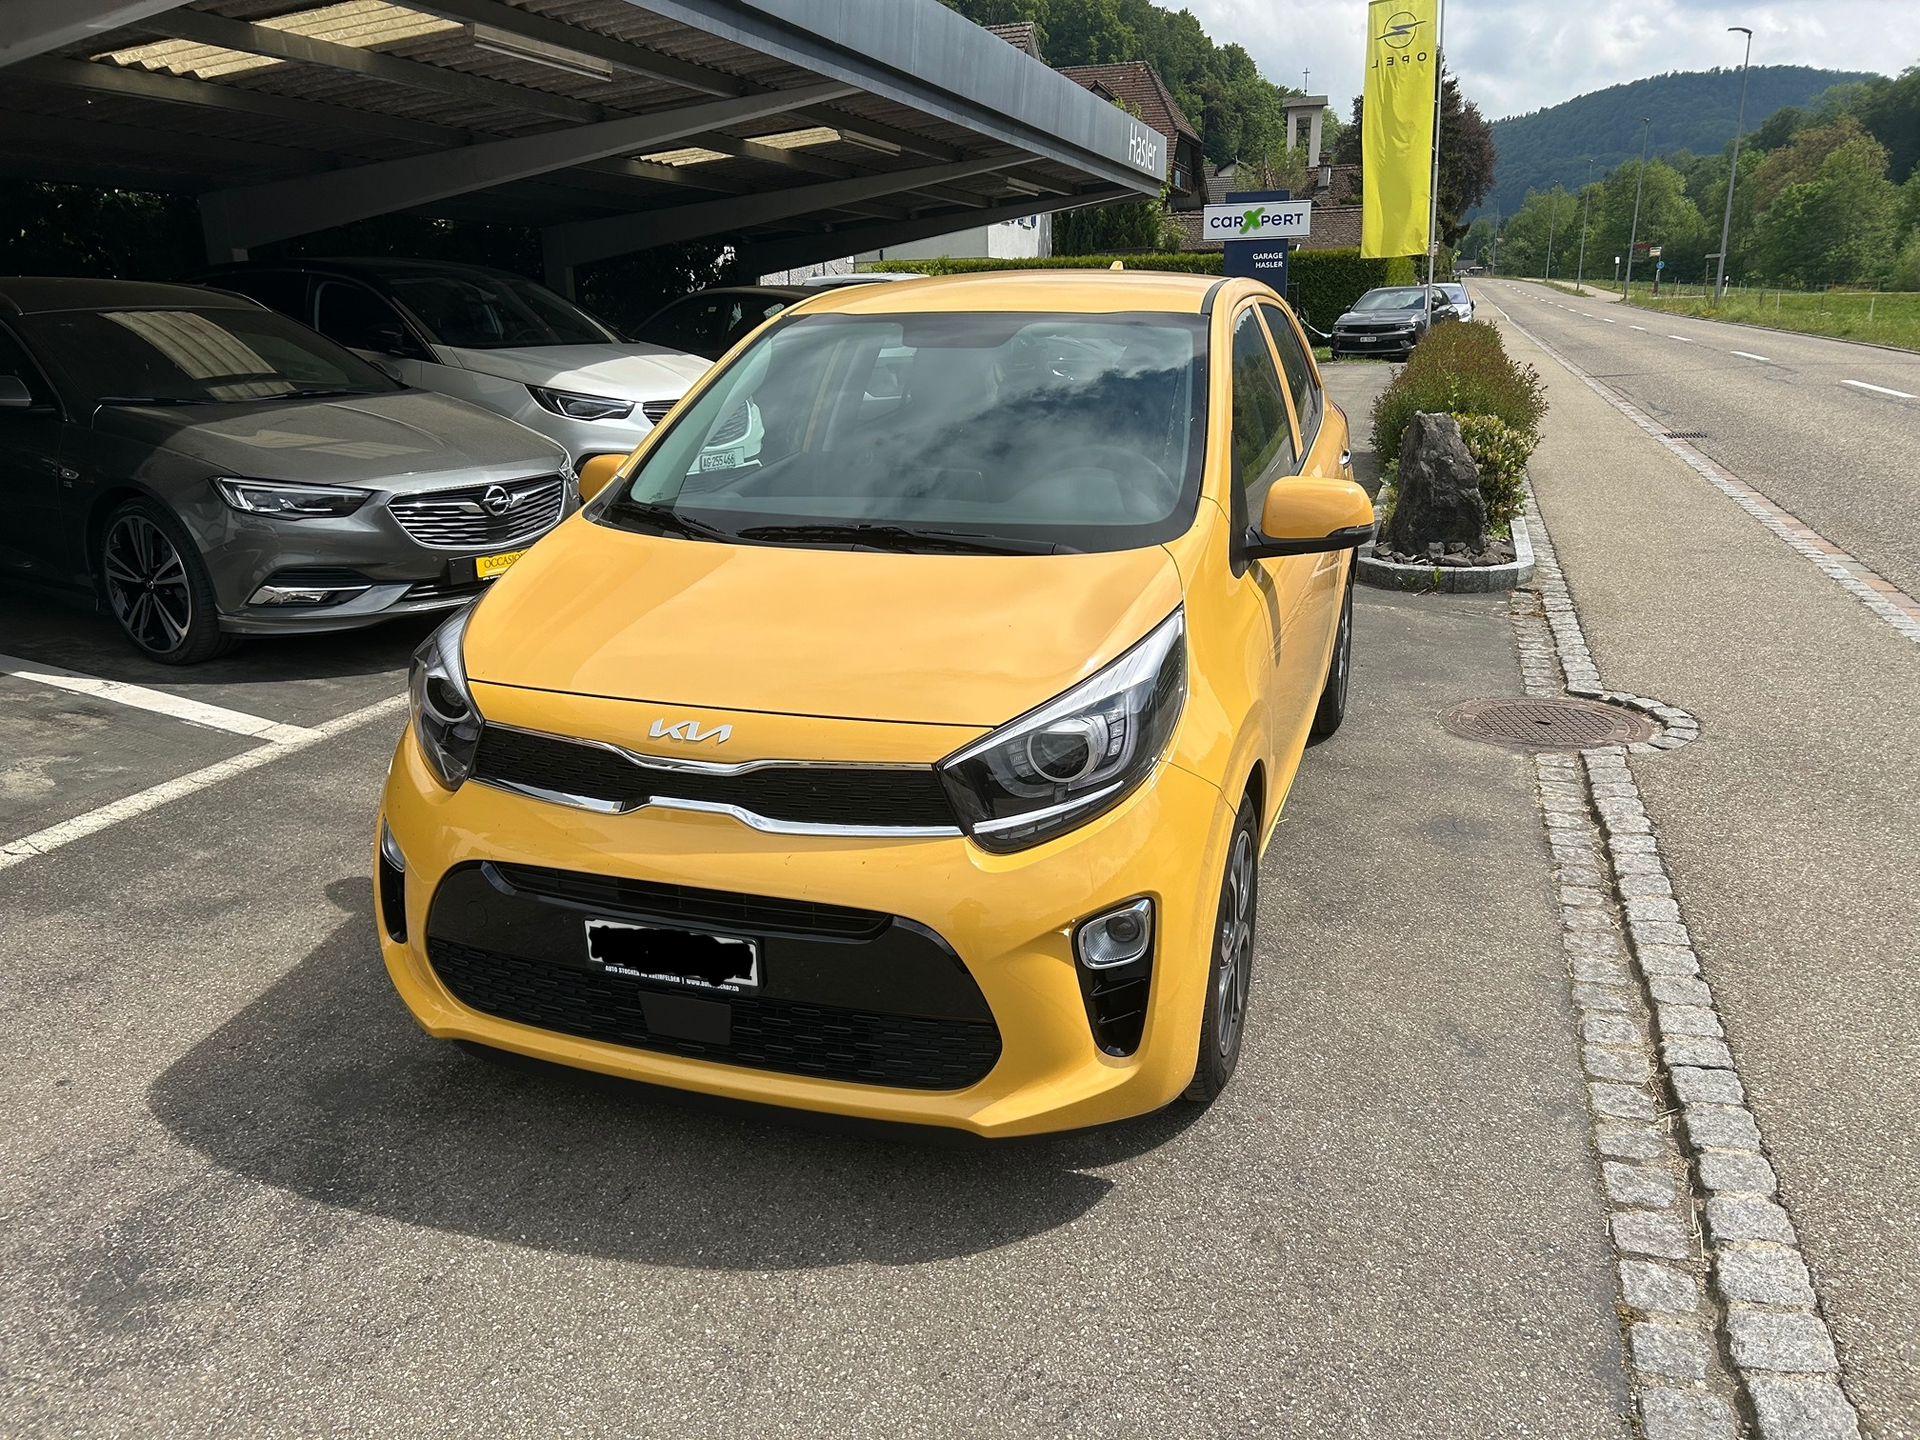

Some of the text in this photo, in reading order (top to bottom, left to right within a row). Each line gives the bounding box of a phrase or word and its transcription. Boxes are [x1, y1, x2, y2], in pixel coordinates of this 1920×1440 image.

[1128, 122, 1157, 171] Hasler
[1252, 252, 1283, 260] GARAGE
[1255, 261, 1283, 269] HASLER
[484, 552, 523, 569] OCCASIO
[649, 717, 733, 744] KIA
[605, 965, 618, 973] AUTO
